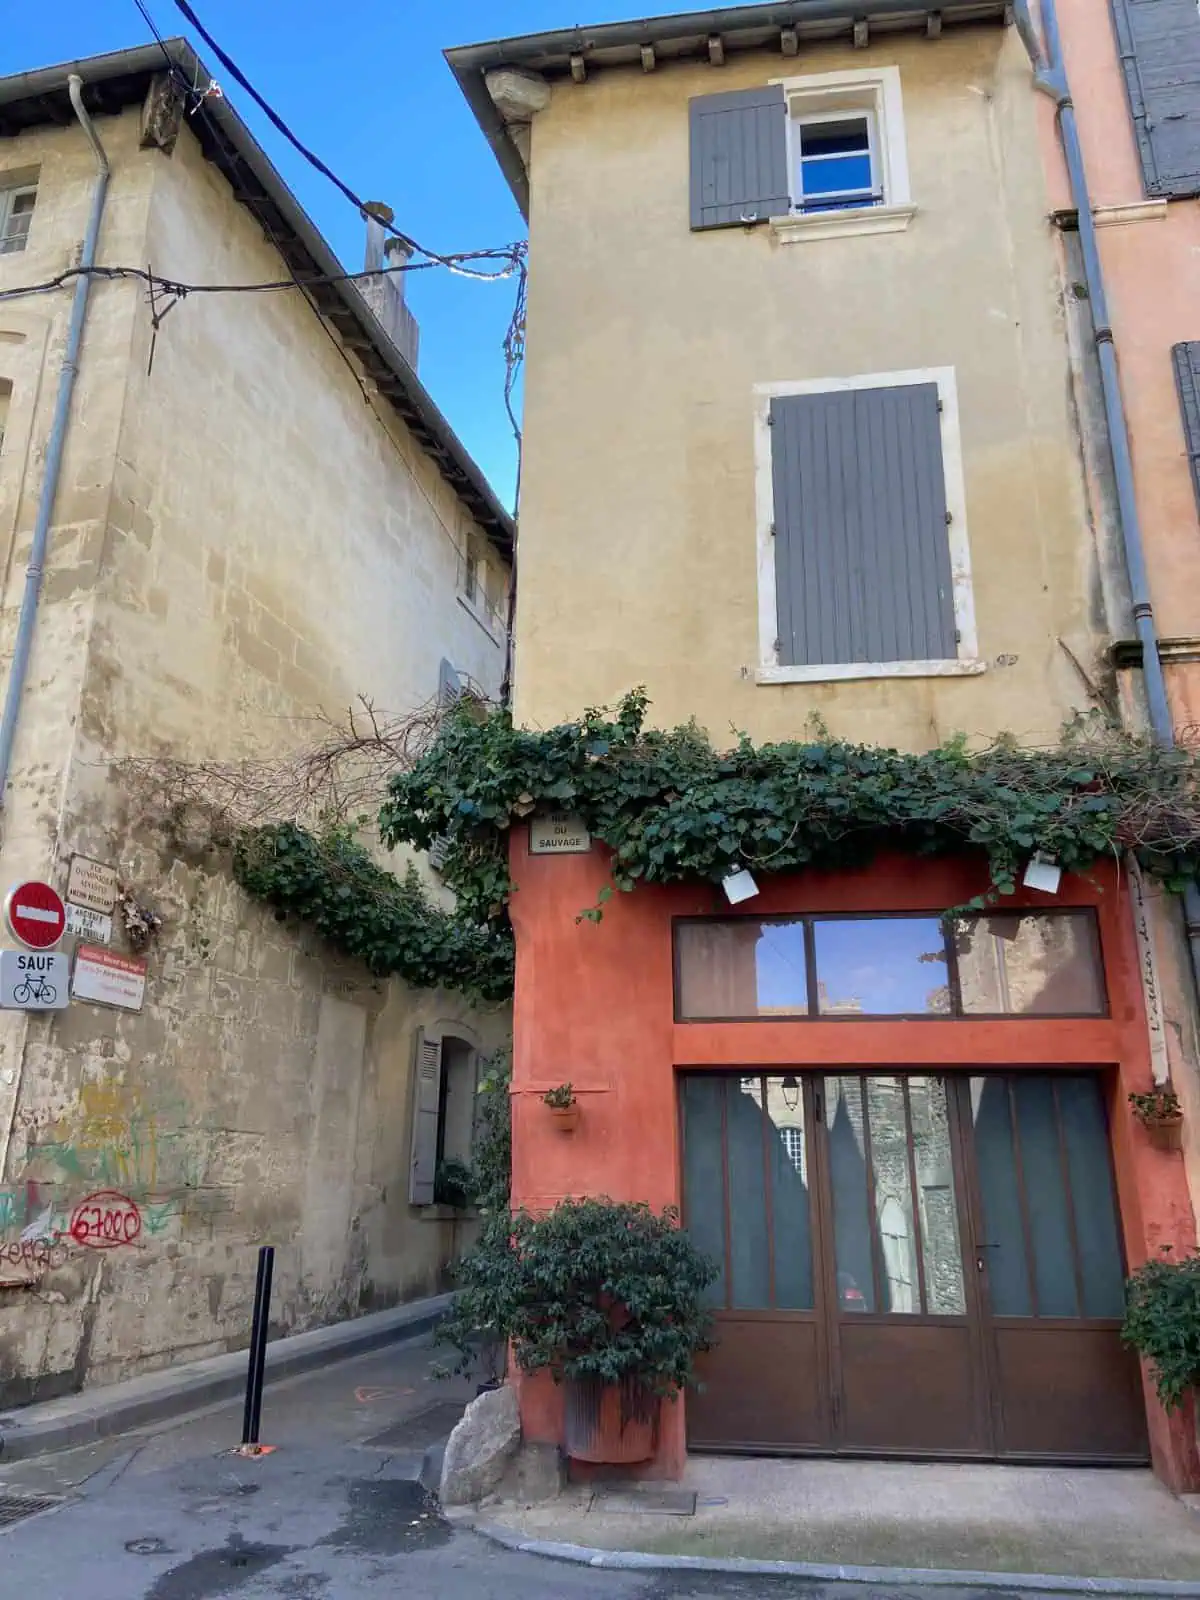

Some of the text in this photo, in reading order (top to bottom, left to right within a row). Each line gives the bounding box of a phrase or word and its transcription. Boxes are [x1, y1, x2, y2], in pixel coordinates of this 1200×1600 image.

[554, 826, 567, 835] DU
[539, 838, 583, 848] SAUVAGE
[17, 955, 55, 971] SAUF
[76, 1206, 139, 1241] 67000
